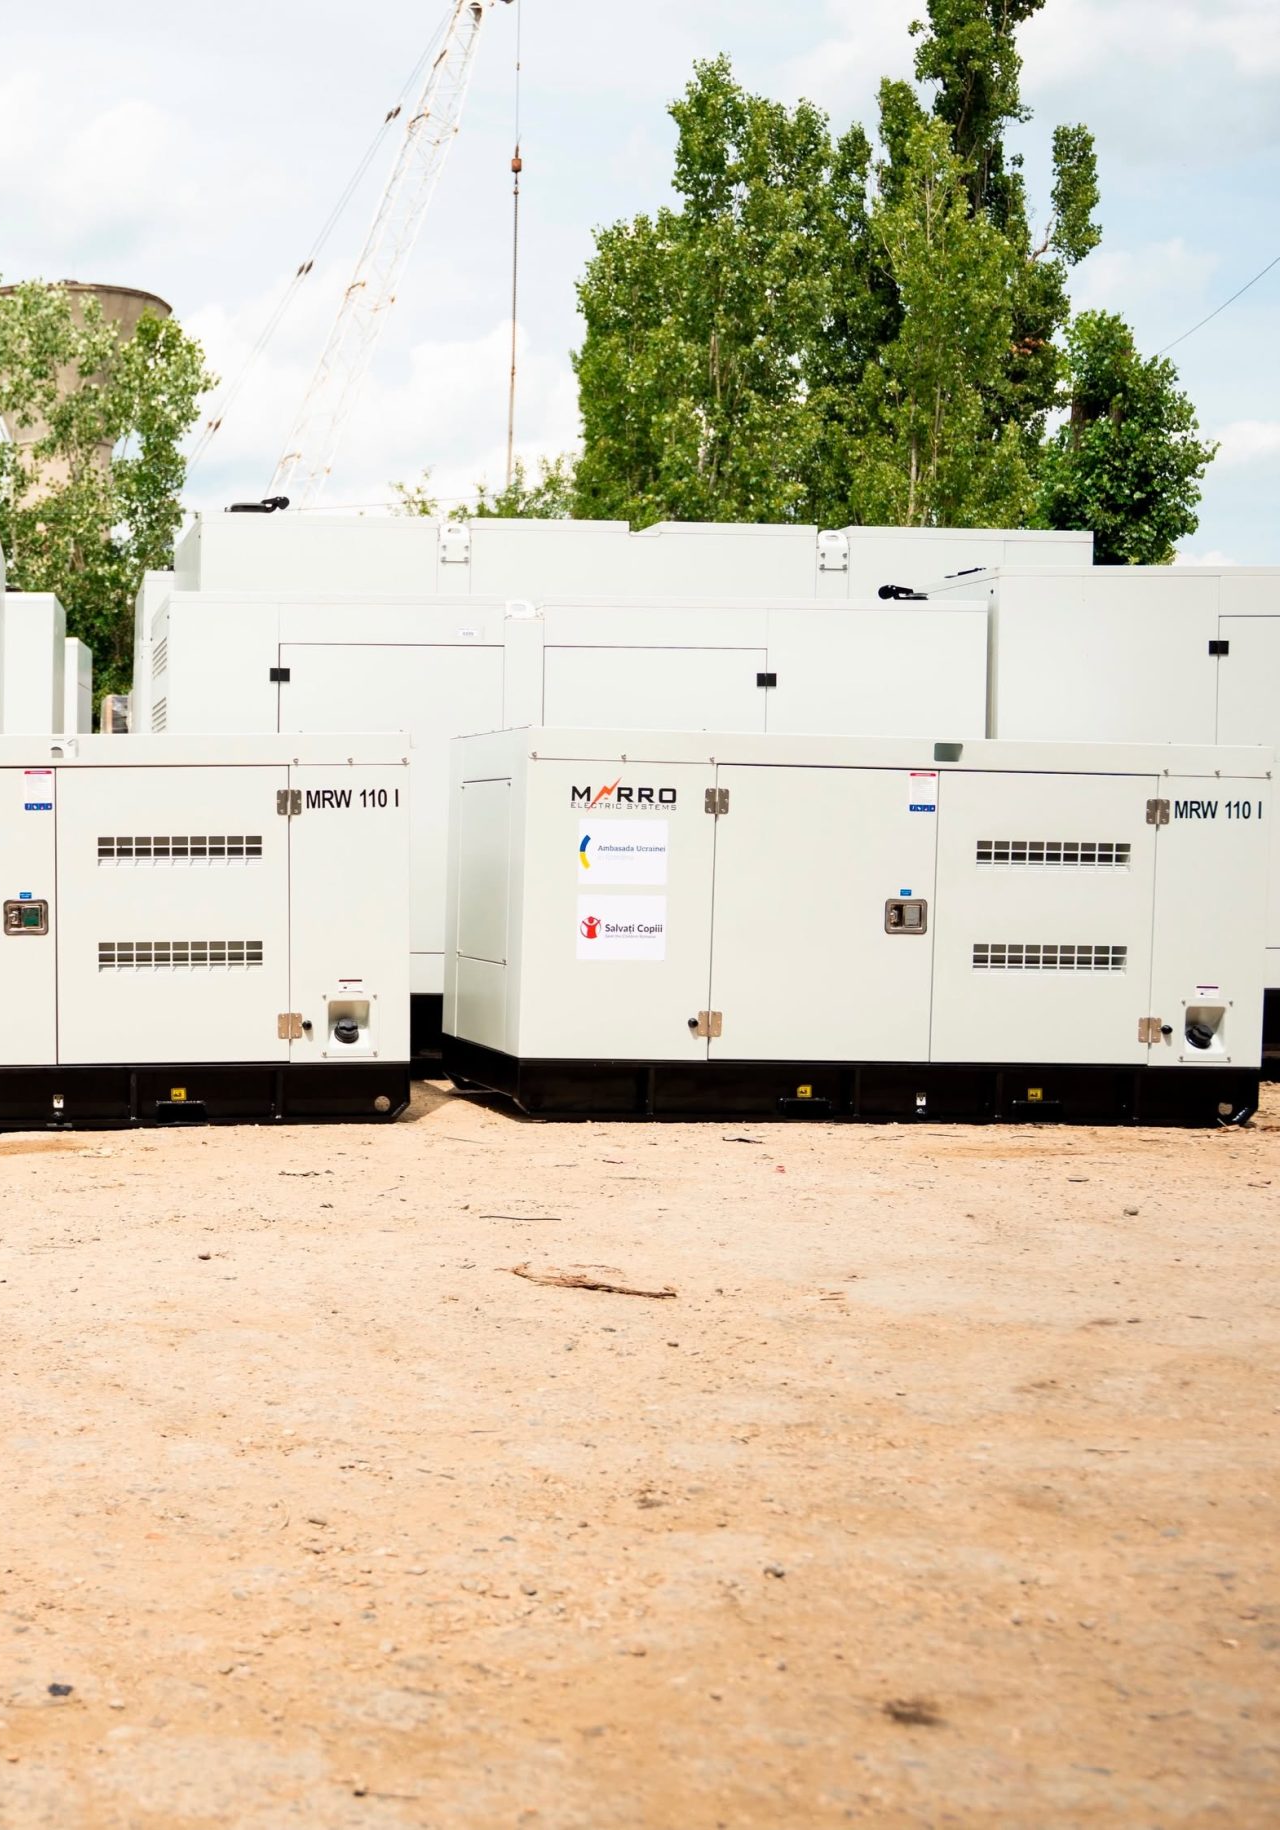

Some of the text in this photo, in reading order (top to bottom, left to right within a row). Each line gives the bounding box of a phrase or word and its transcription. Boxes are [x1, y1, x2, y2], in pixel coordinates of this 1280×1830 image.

[306, 788, 400, 809] MRW 110 I
[570, 801, 678, 811] ELECTRIC SYSTEMS
[1174, 800, 1263, 820] MRW 110 I
[597, 844, 635, 852] Ambasada
[637, 924, 664, 935] Copiii
